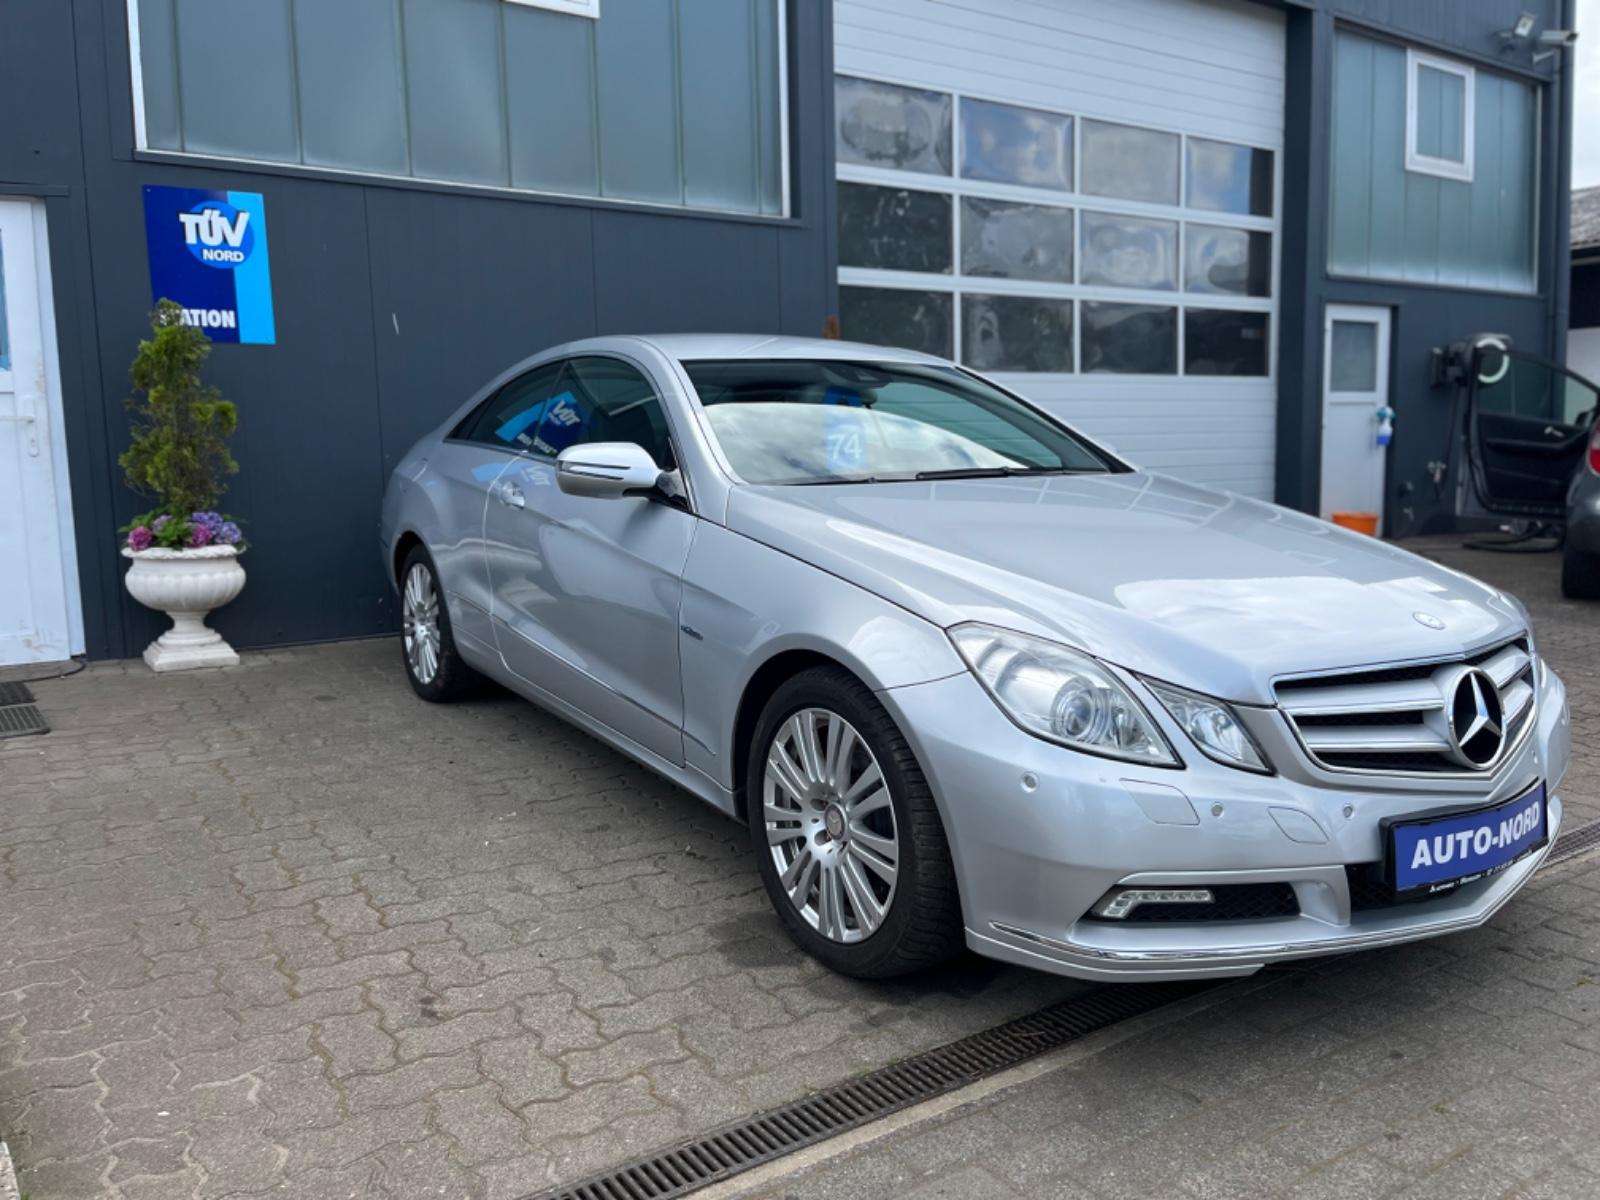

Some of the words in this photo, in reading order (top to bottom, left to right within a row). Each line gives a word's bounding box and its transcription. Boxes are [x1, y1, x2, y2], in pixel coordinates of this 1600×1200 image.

[179, 209, 250, 248] TÜV
[202, 249, 245, 263] NORD
[160, 308, 236, 328] ATION
[827, 432, 863, 459] 74
[1411, 801, 1540, 869] AUTO-NORD
